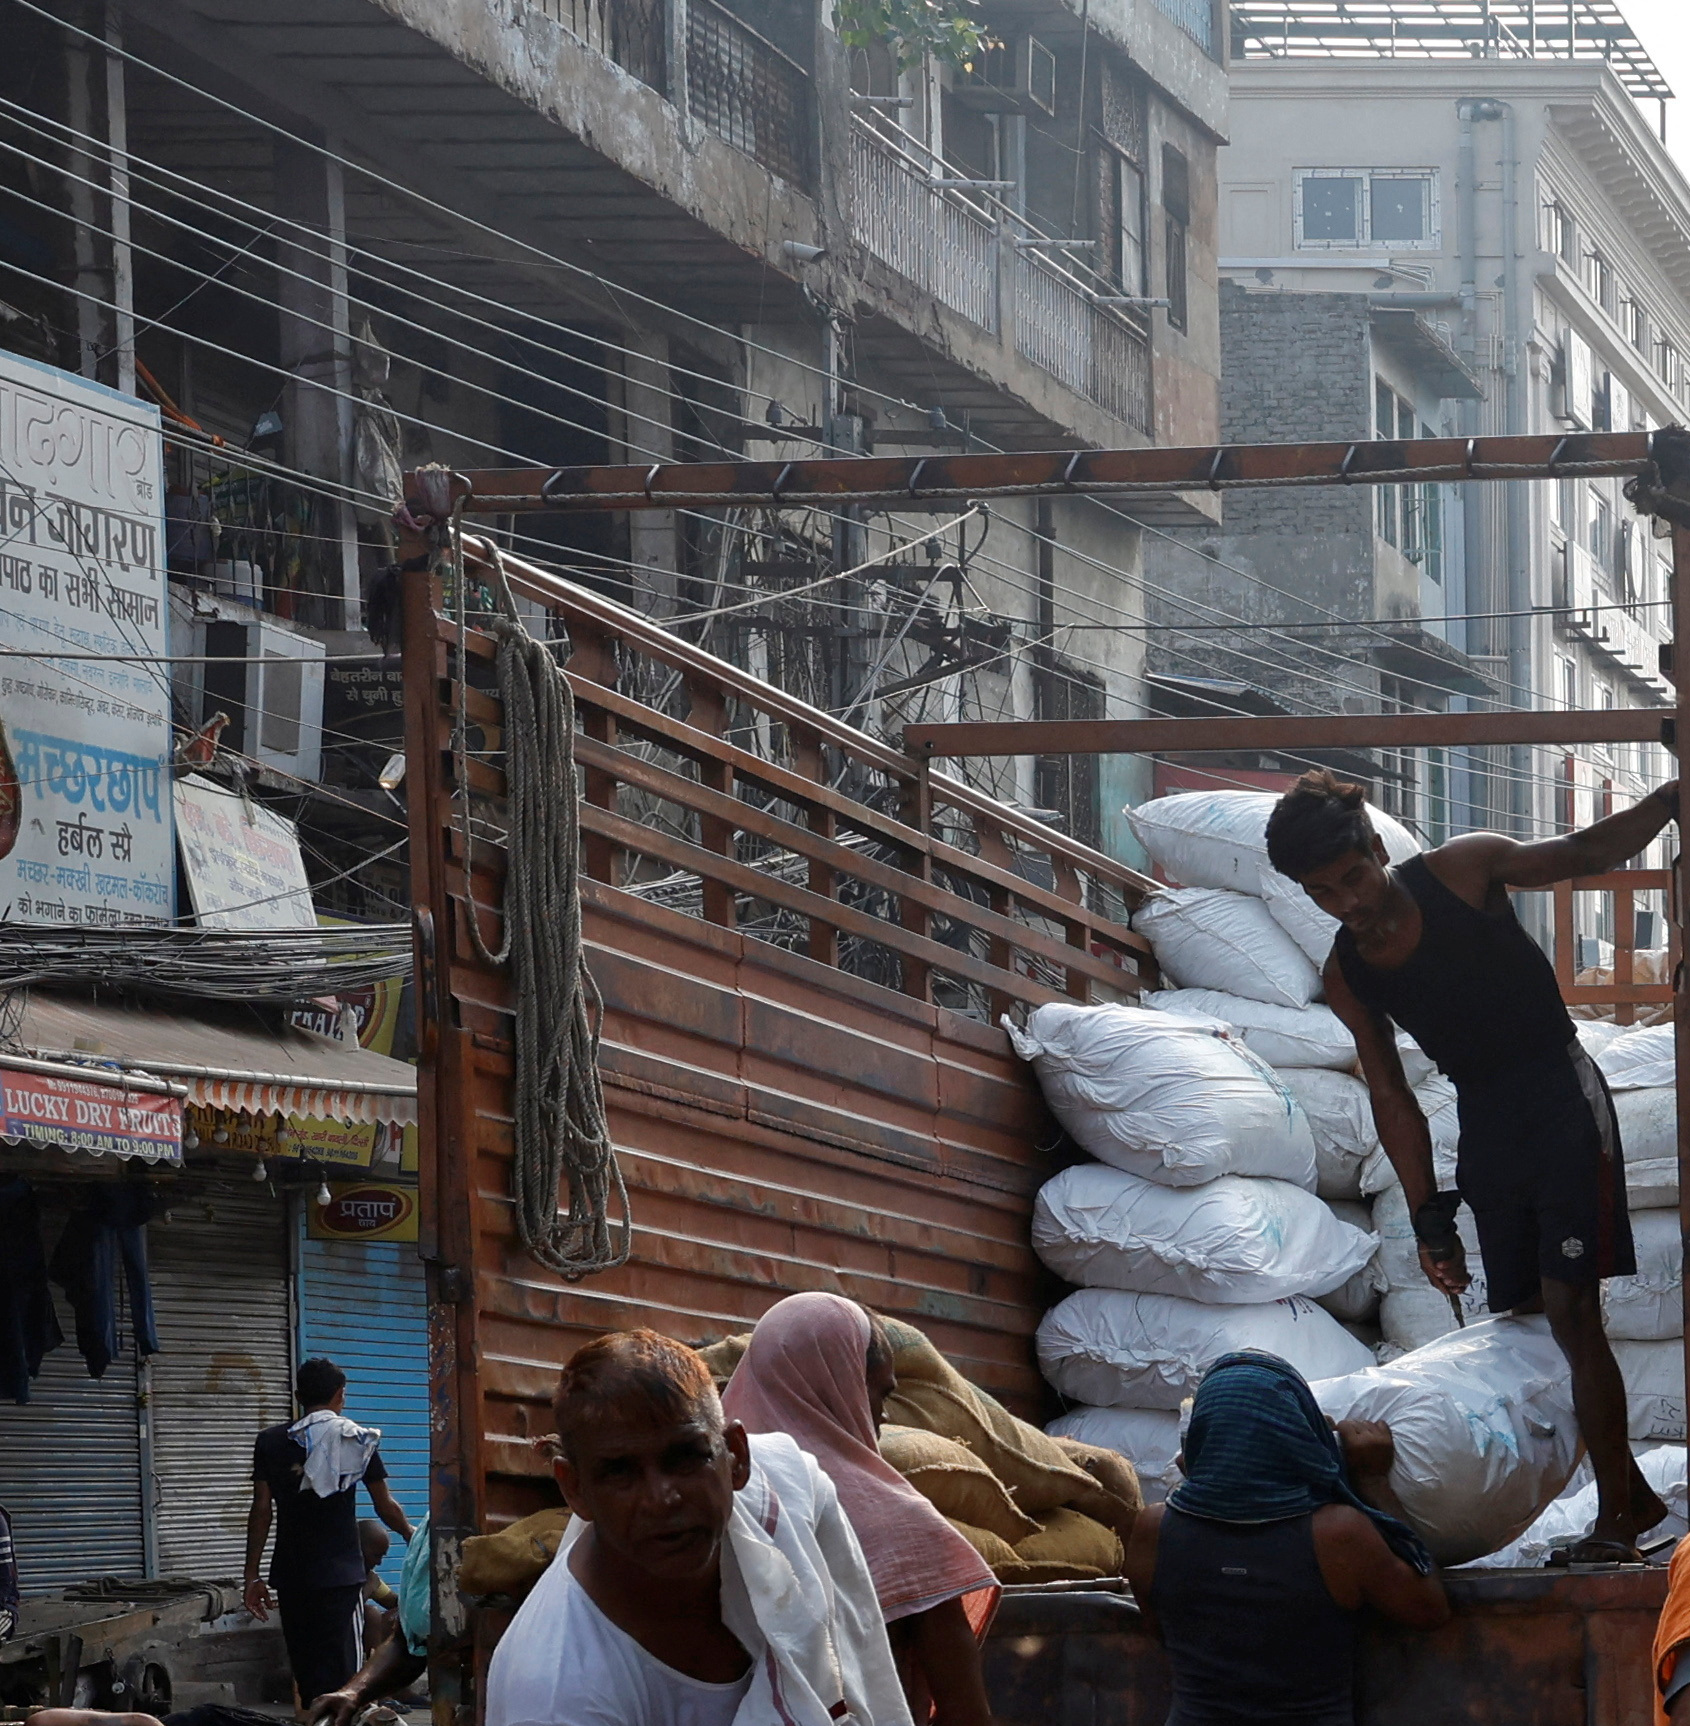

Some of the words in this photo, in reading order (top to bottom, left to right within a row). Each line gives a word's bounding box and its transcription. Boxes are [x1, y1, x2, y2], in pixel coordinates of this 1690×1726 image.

[44, 490, 157, 580] जागरण
[37, 563, 59, 602] का
[63, 566, 101, 614] सभी
[104, 582, 160, 631] सामान
[329, 667, 384, 684] बेहतरीन
[345, 686, 359, 701] से
[12, 727, 162, 825] मच्छरछाप
[55, 811, 105, 860] हर्बल
[17, 890, 34, 917] को
[35, 896, 67, 922] भगाने
[67, 904, 84, 925] का
[4, 1087, 70, 1123] LUCKY
[74, 1099, 117, 1129] DRY
[117, 1106, 183, 1138] FRUITS
[22, 1122, 69, 1144] TIMING:
[70, 1132, 95, 1149] 8:00
[95, 1135, 114, 1150] AM
[115, 1137, 131, 1152] TO
[132, 1139, 155, 1155] 9:00
[156, 1142, 175, 1158] PM
[339, 1197, 397, 1219] प्रताप
